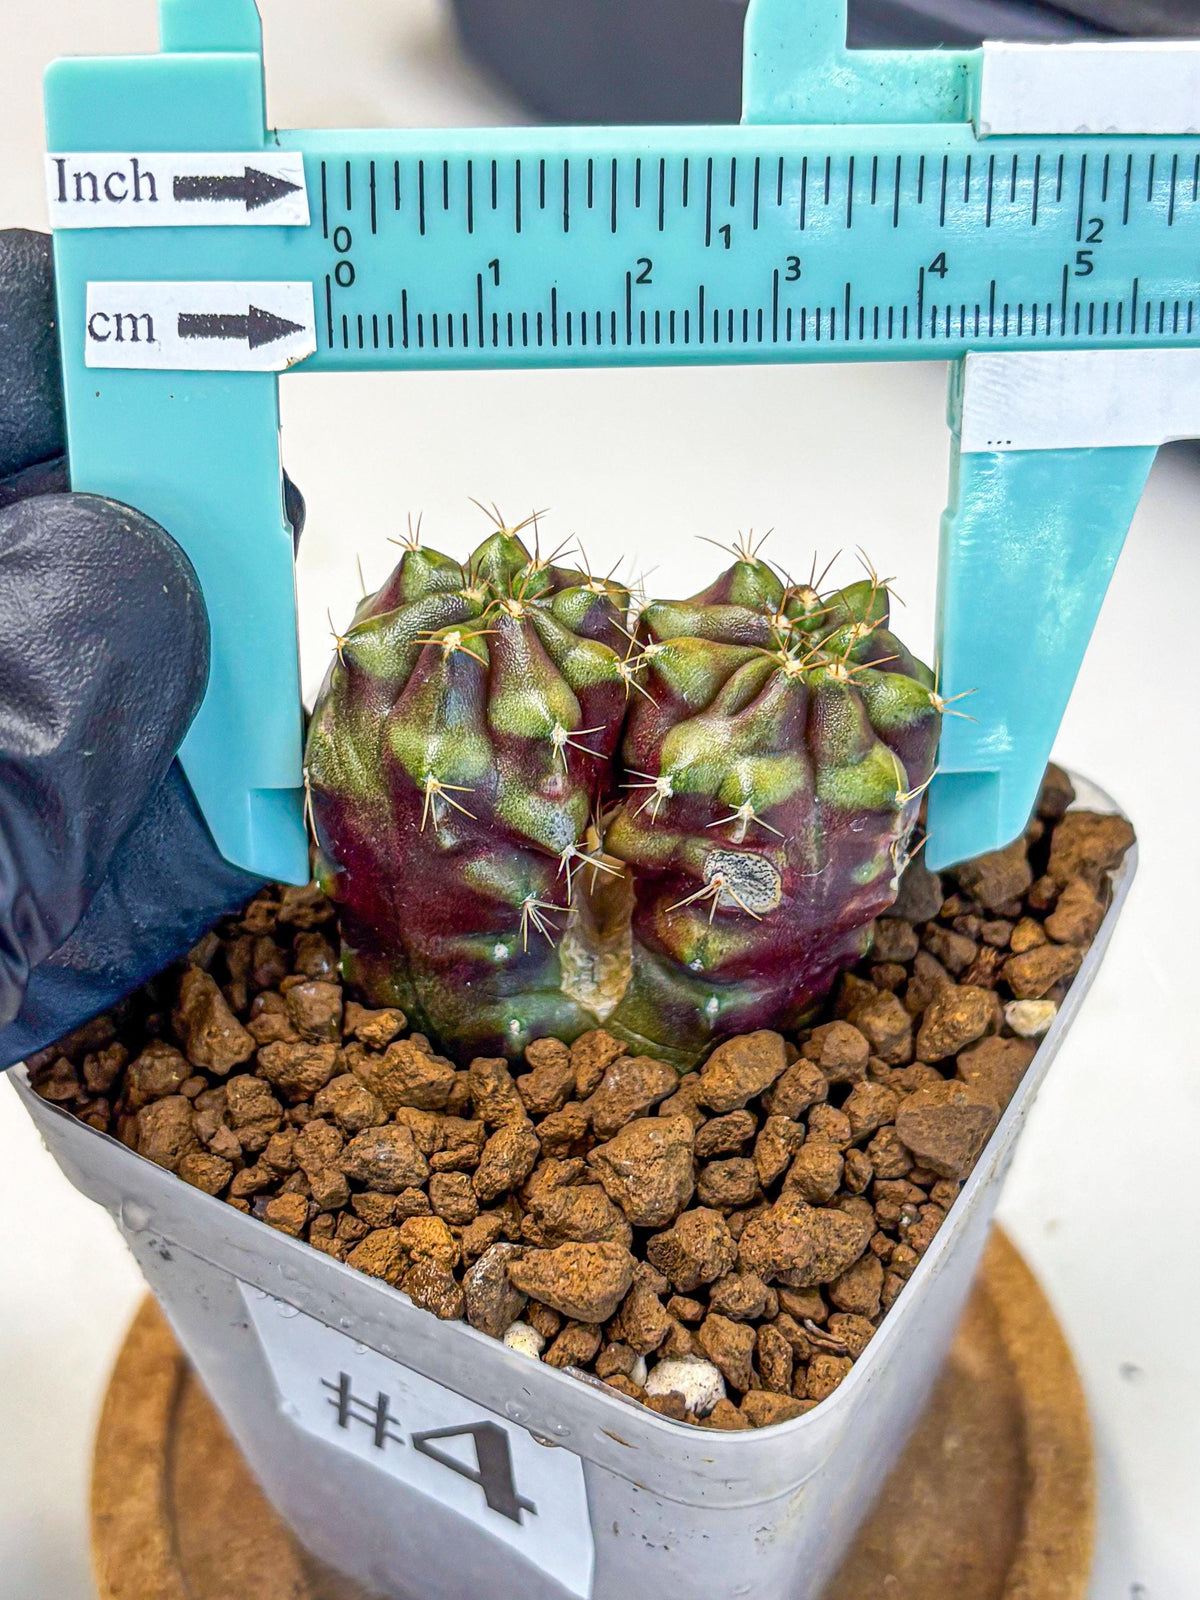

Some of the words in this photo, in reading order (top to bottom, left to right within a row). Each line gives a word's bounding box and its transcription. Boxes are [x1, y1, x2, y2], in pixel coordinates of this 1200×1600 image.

[52, 158, 159, 204] Inch
[333, 226, 352, 254] 0
[718, 224, 731, 250] 1
[1086, 218, 1105, 244] 2
[334, 260, 356, 288] 0
[487, 258, 502, 287] 1
[635, 258, 653, 285] 2
[785, 255, 802, 282] 3
[928, 252, 949, 279] 4
[1075, 250, 1094, 277] 5
[87, 310, 156, 344] cm
[319, 1371, 538, 1526] #4
